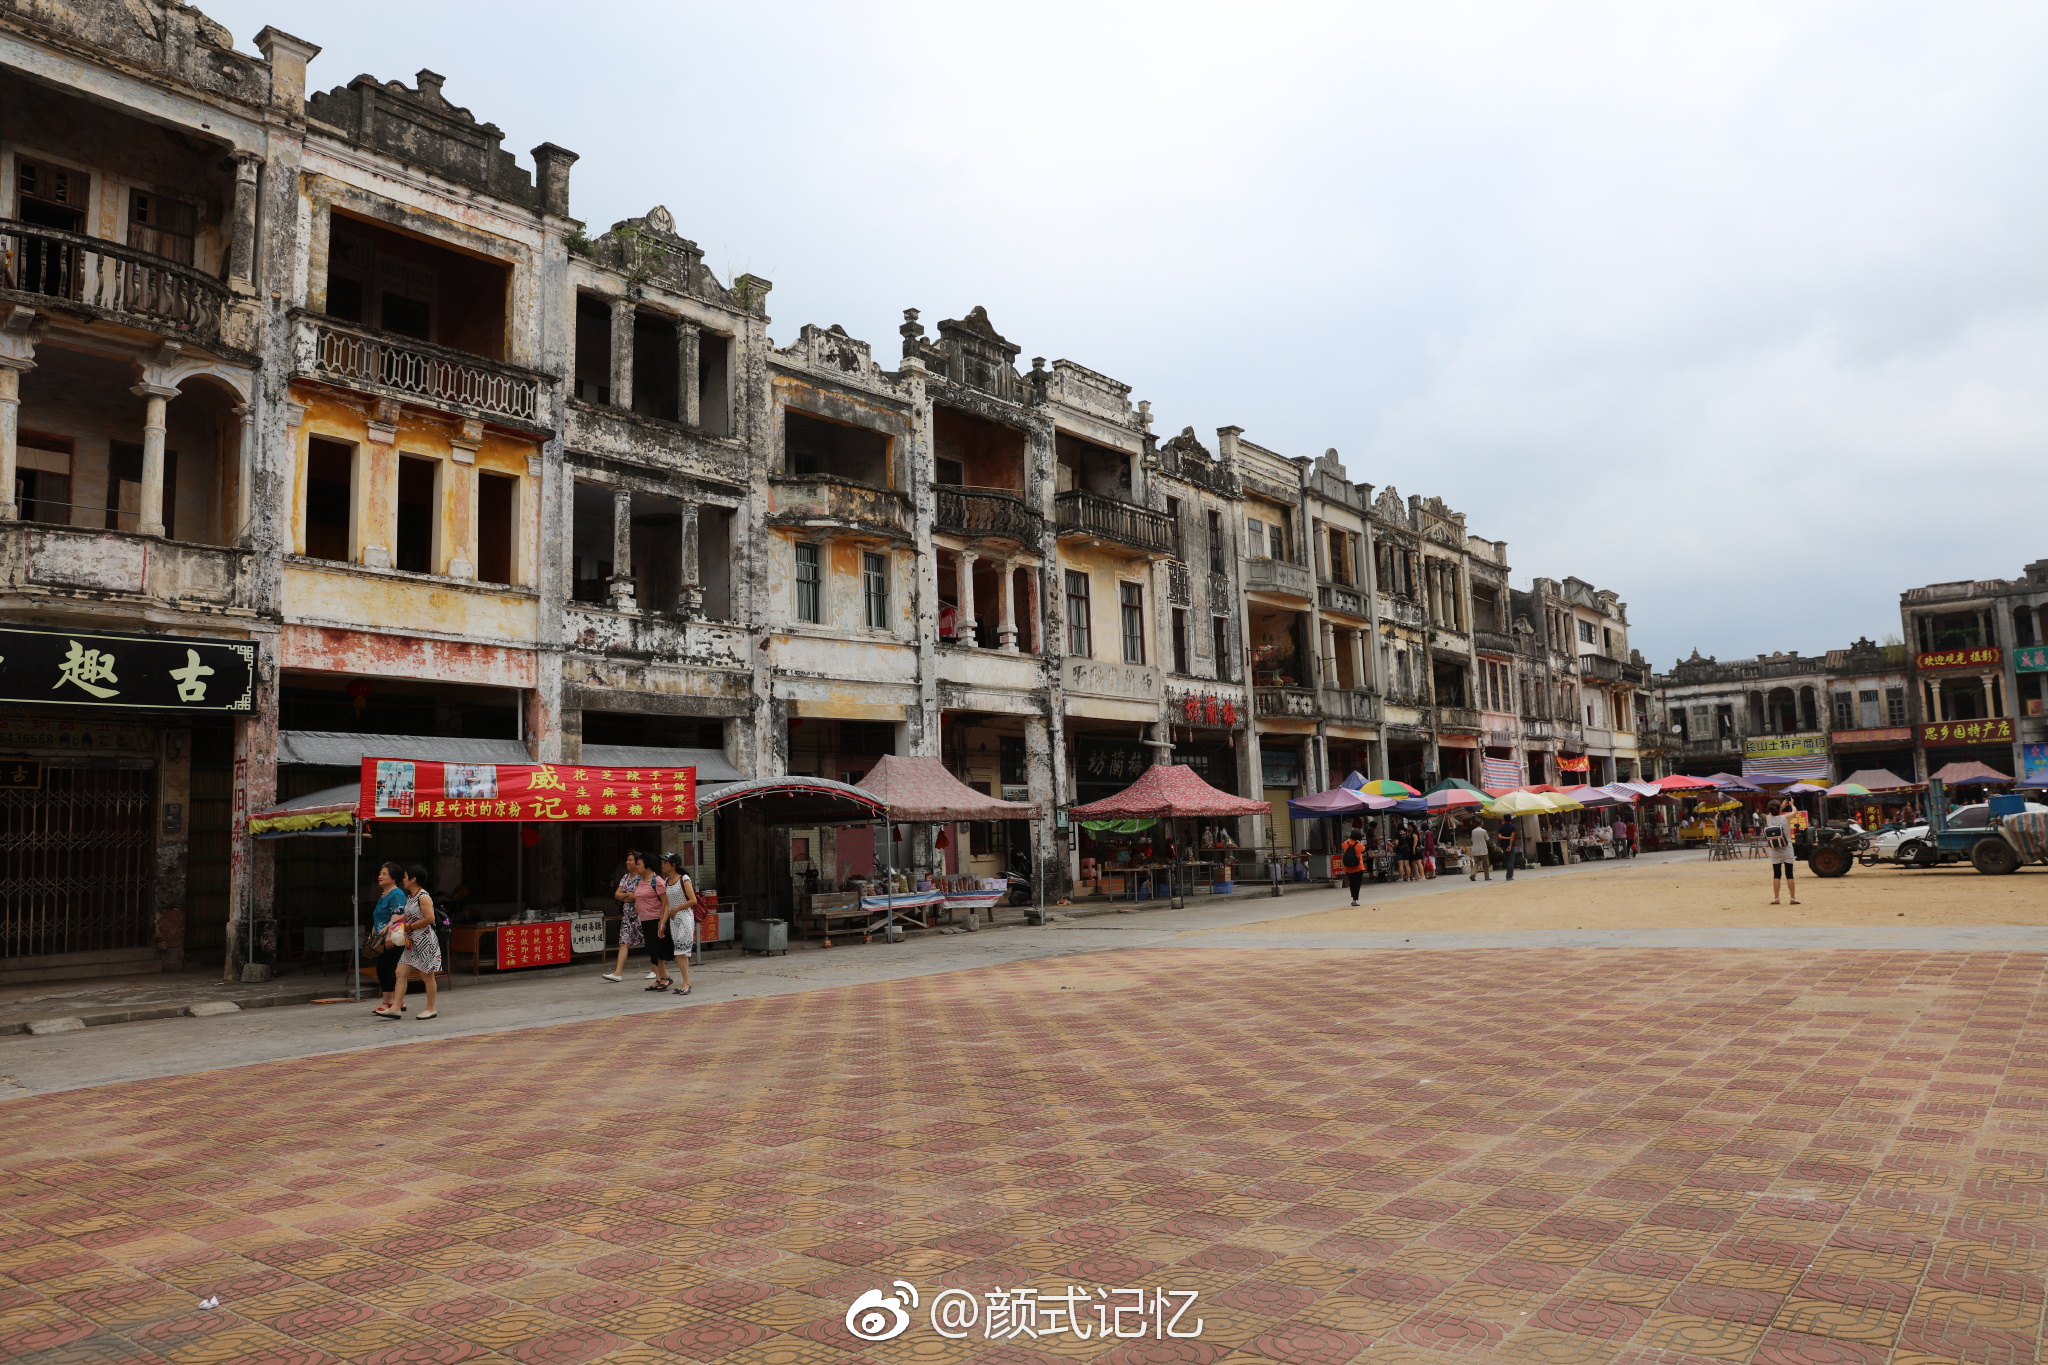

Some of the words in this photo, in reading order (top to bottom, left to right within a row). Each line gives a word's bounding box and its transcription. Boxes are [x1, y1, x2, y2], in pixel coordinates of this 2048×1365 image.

[1745, 737, 1826, 752] 长山土特产商行
[1924, 720, 2012, 741] 思乡园特产店
[417, 799, 522, 818] 明星吃过的凉粉
[526, 763, 569, 819] 威记
[573, 768, 591, 816] 花生糖
[601, 769, 618, 816] 芝麻糖
[626, 770, 643, 816] 辣姜糖
[649, 770, 664, 816] 手工制作
[672, 771, 687, 816] 现做现卖
[232, 755, 247, 876] 古旧杂物
[505, 928, 517, 966] 威记花生糖
[572, 933, 604, 945] 儿时的味道
[706, 915, 718, 940] 豆腐花
